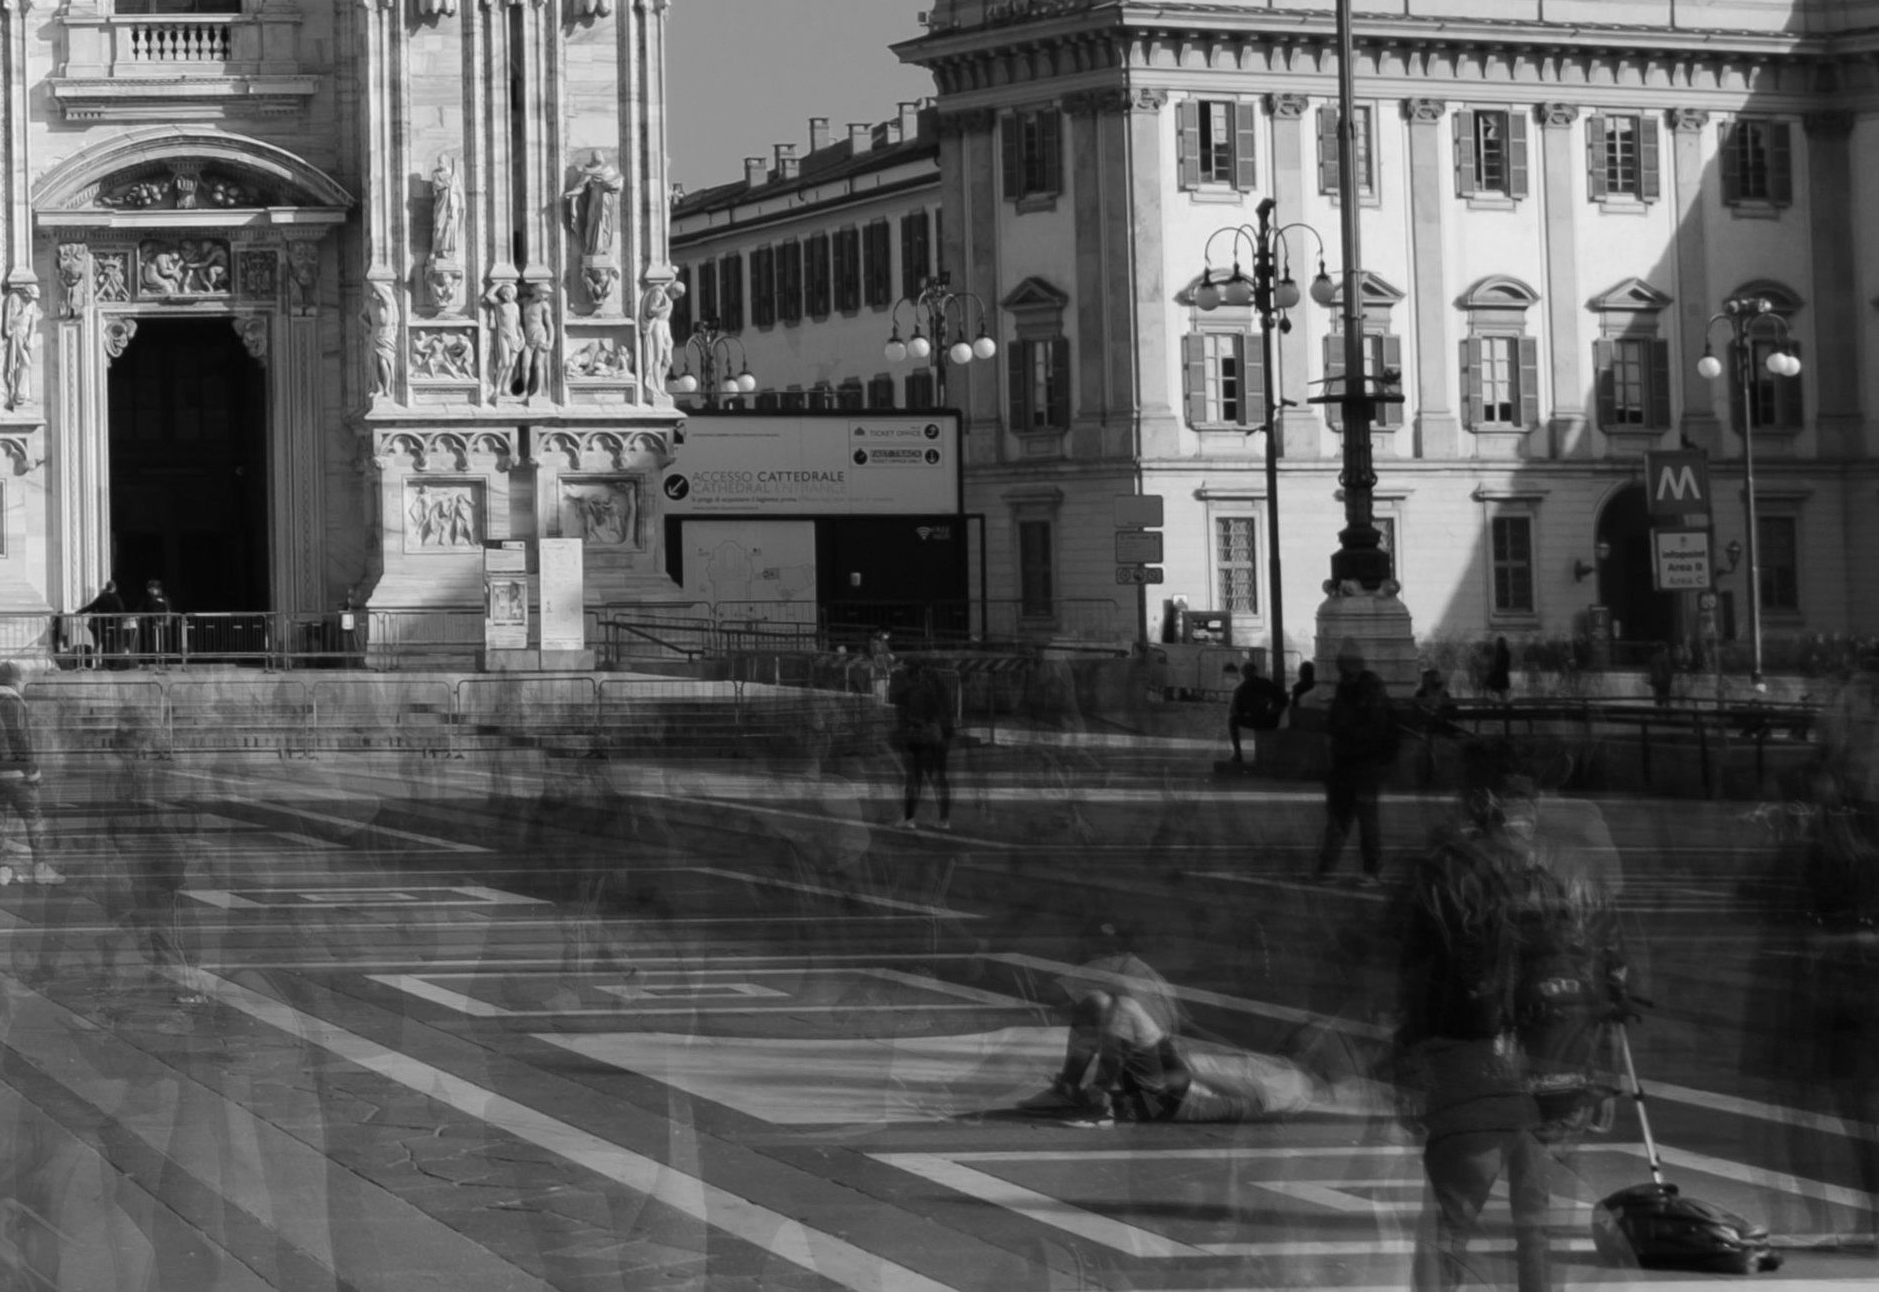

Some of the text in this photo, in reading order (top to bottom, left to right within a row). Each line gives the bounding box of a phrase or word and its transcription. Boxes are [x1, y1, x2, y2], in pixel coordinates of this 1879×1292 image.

[691, 471, 845, 482] ACCESSO CATTEDRALE
[1656, 465, 1702, 500] M
[691, 483, 847, 494] CATHEDRAL ENTRANCE
[1667, 562, 1693, 571] Area
[1668, 576, 1694, 585] Area
